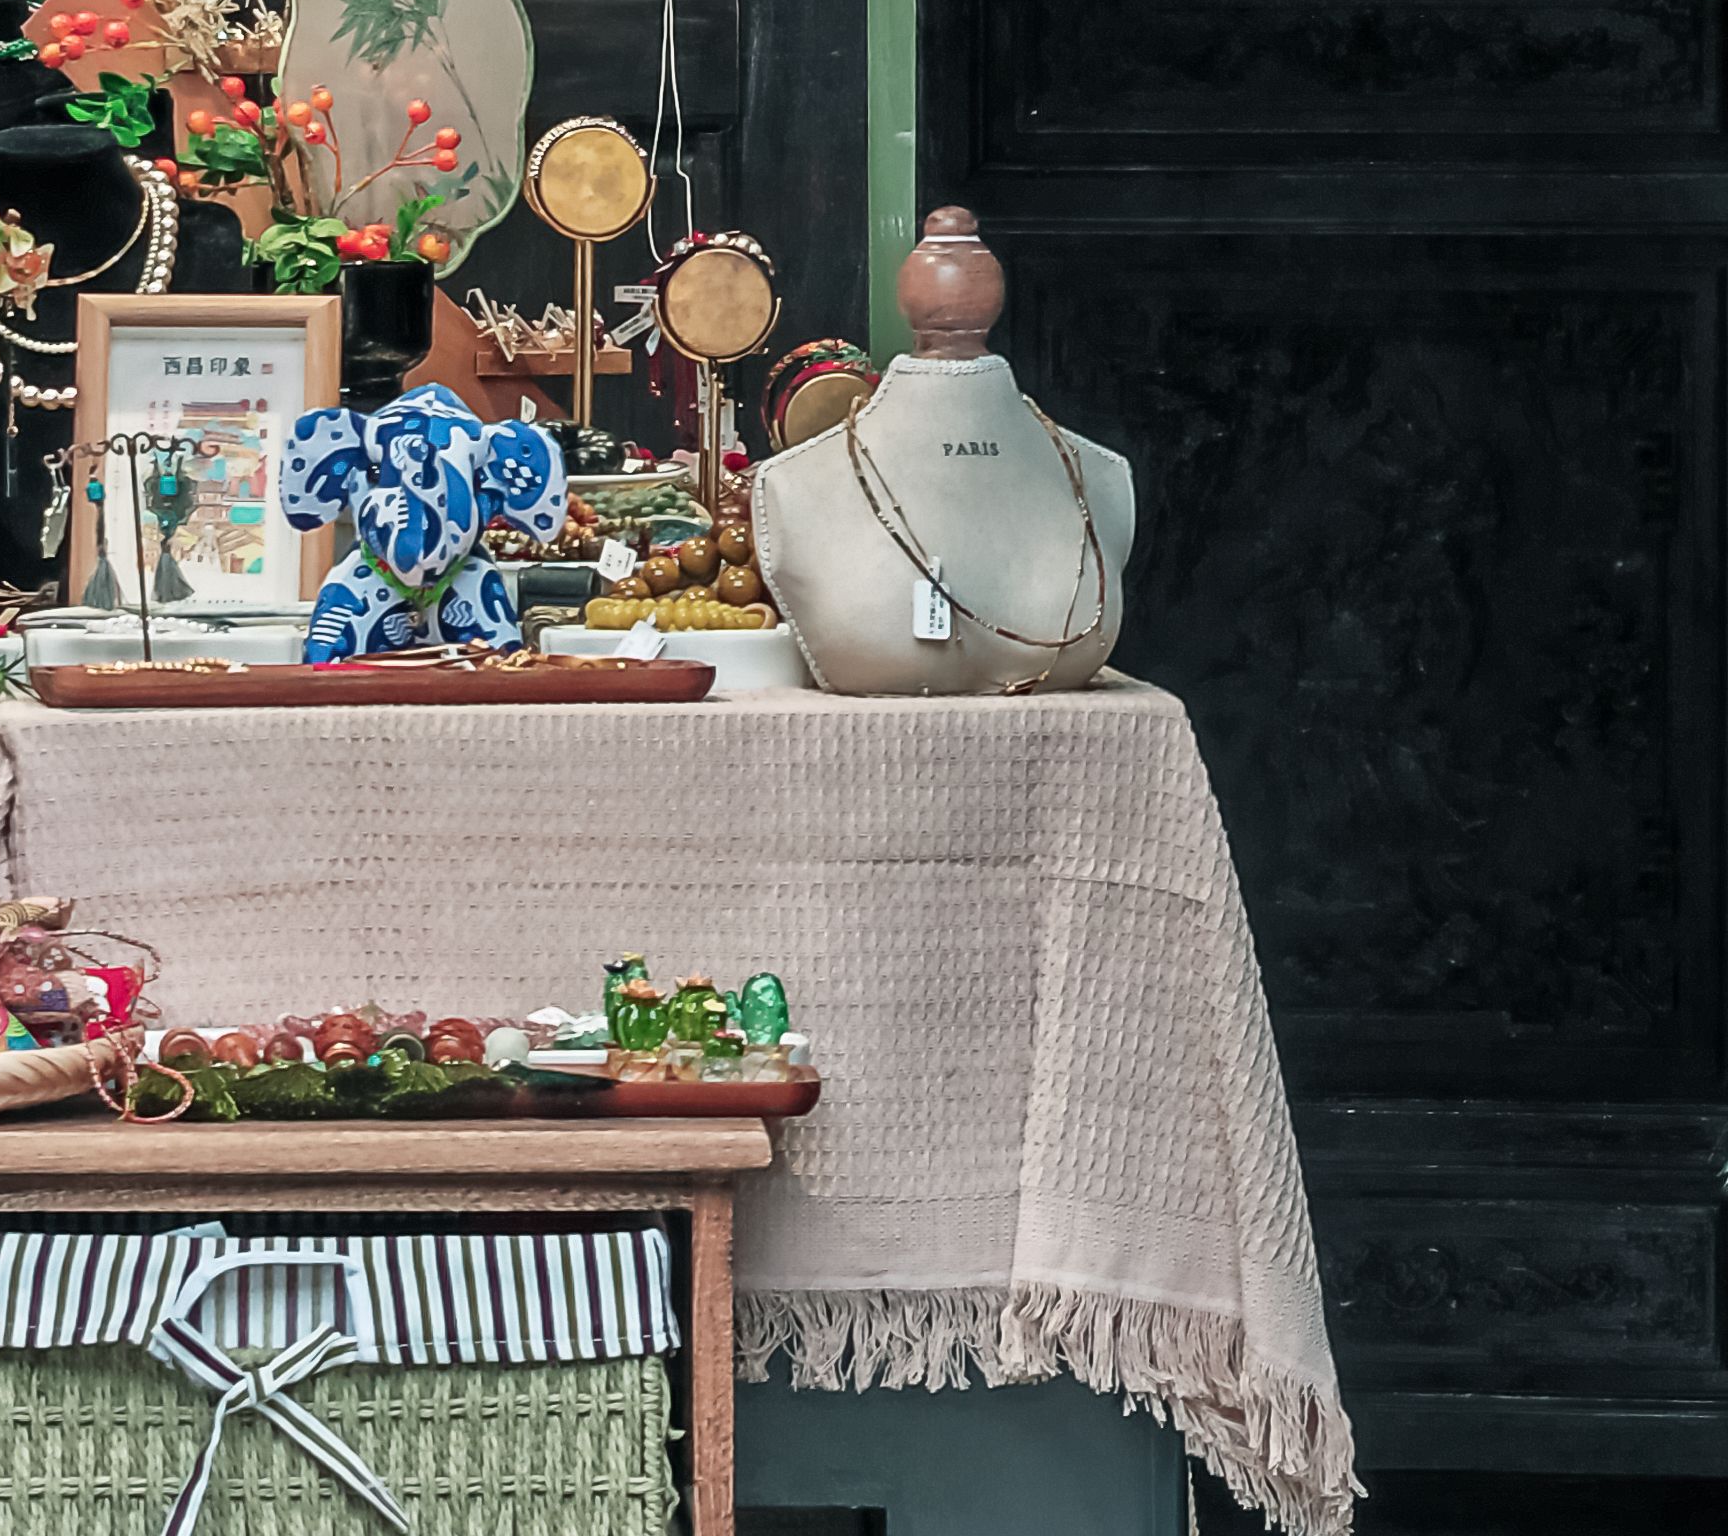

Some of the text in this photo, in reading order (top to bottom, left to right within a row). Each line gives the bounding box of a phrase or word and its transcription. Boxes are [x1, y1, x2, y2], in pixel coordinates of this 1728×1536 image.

[162, 356, 251, 376] 西昌印象
[943, 441, 1000, 457] PARIS
